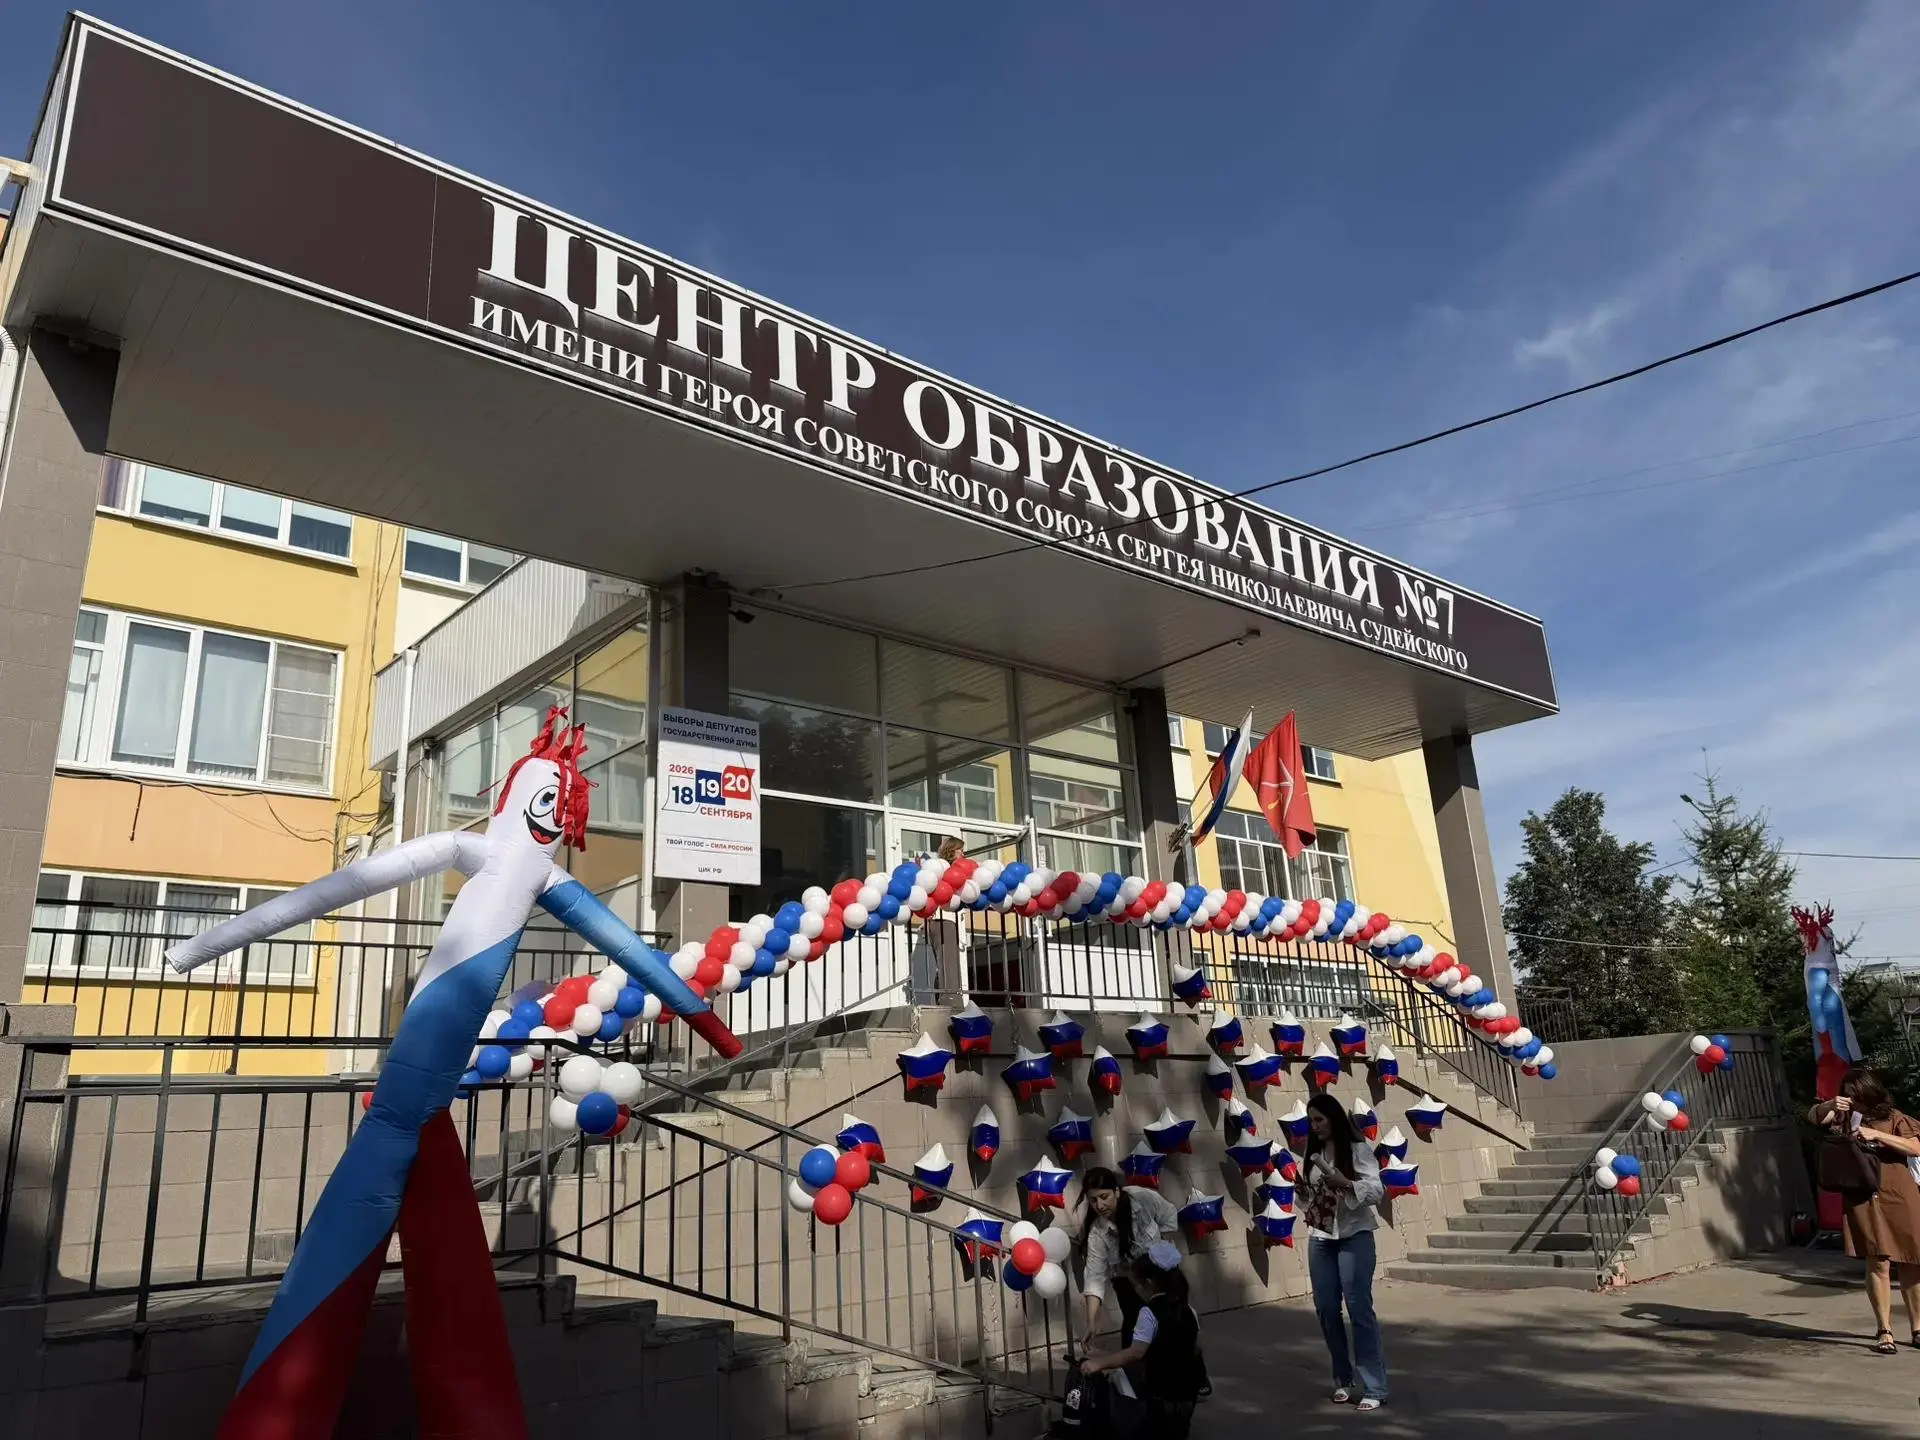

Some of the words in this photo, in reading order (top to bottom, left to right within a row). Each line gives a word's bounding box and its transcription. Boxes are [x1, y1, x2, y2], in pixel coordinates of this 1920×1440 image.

[478, 197, 876, 416] ЦЕНТР
[903, 381, 1385, 614] ОБРАЗОВАНИЯ
[1392, 570, 1454, 635] №7
[469, 296, 648, 387] ИМЕНИ
[657, 363, 786, 436] ГЕРОЯ
[794, 417, 1009, 514] СОВЕТСКОГО
[1016, 497, 1113, 551] СОЮЗА
[1117, 533, 1206, 582] СЕРГЕЯ
[1208, 563, 1358, 634] НИКОЛАЕВИЧА
[1360, 618, 1468, 670] СУДЕЙСКОГО
[663, 714, 704, 727] ВЫБОРЫ
[705, 720, 757, 736] ДЕПУТАТОВ
[663, 727, 735, 744] ГОСУДАРСТВЕННОЙ
[735, 739, 757, 748] ДУМЫ
[668, 764, 694, 775] 2026
[671, 785, 694, 805] 18
[697, 778, 720, 798] 19
[723, 772, 750, 793] 20
[699, 806, 753, 820] СЕНТЯБРЯ
[666, 837, 682, 845] ТВОЙ
[683, 840, 704, 848] ГОЛОС
[710, 842, 727, 850] СИЛА
